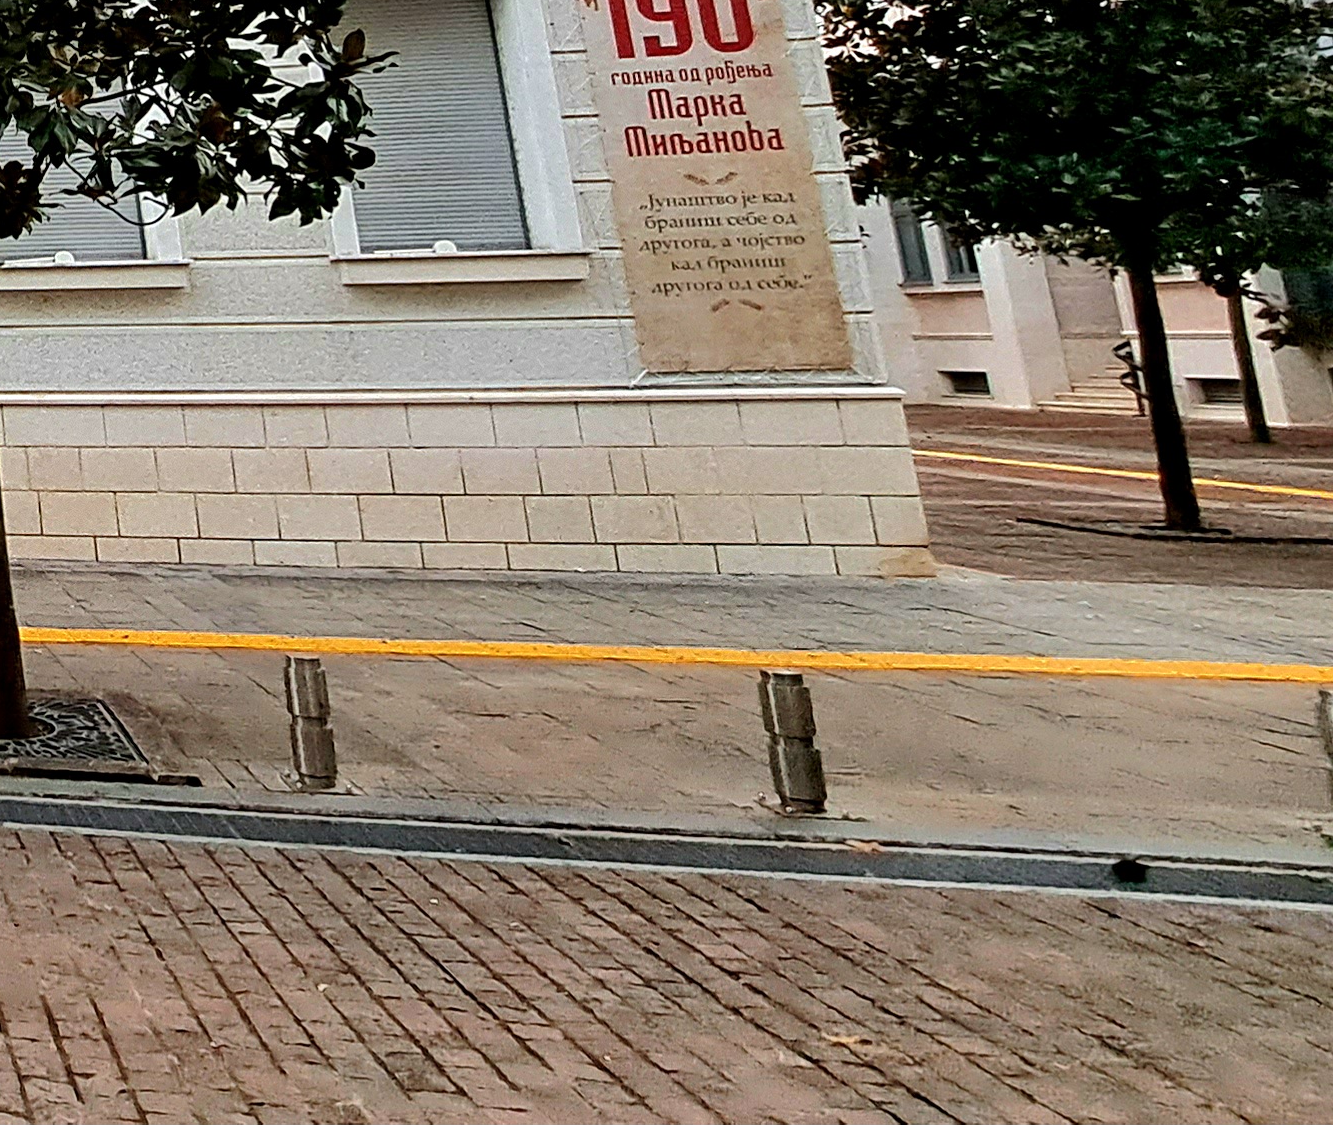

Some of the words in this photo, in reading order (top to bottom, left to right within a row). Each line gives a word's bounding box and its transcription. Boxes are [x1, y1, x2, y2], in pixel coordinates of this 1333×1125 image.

[611, 67, 676, 85] година
[680, 68, 702, 83] од
[706, 60, 773, 85] рођења
[648, 89, 747, 126] Марка
[624, 121, 785, 157] Миљанова
[740, 191, 760, 210] је
[762, 192, 796, 204] кад
[645, 215, 723, 233] браниш
[726, 212, 767, 227] себе
[771, 214, 797, 225] од
[722, 239, 733, 248] а
[736, 234, 806, 252] чојство
[671, 260, 703, 271] кад
[707, 256, 787, 274] браниш
[651, 280, 723, 297] другога
[728, 280, 752, 291] од
